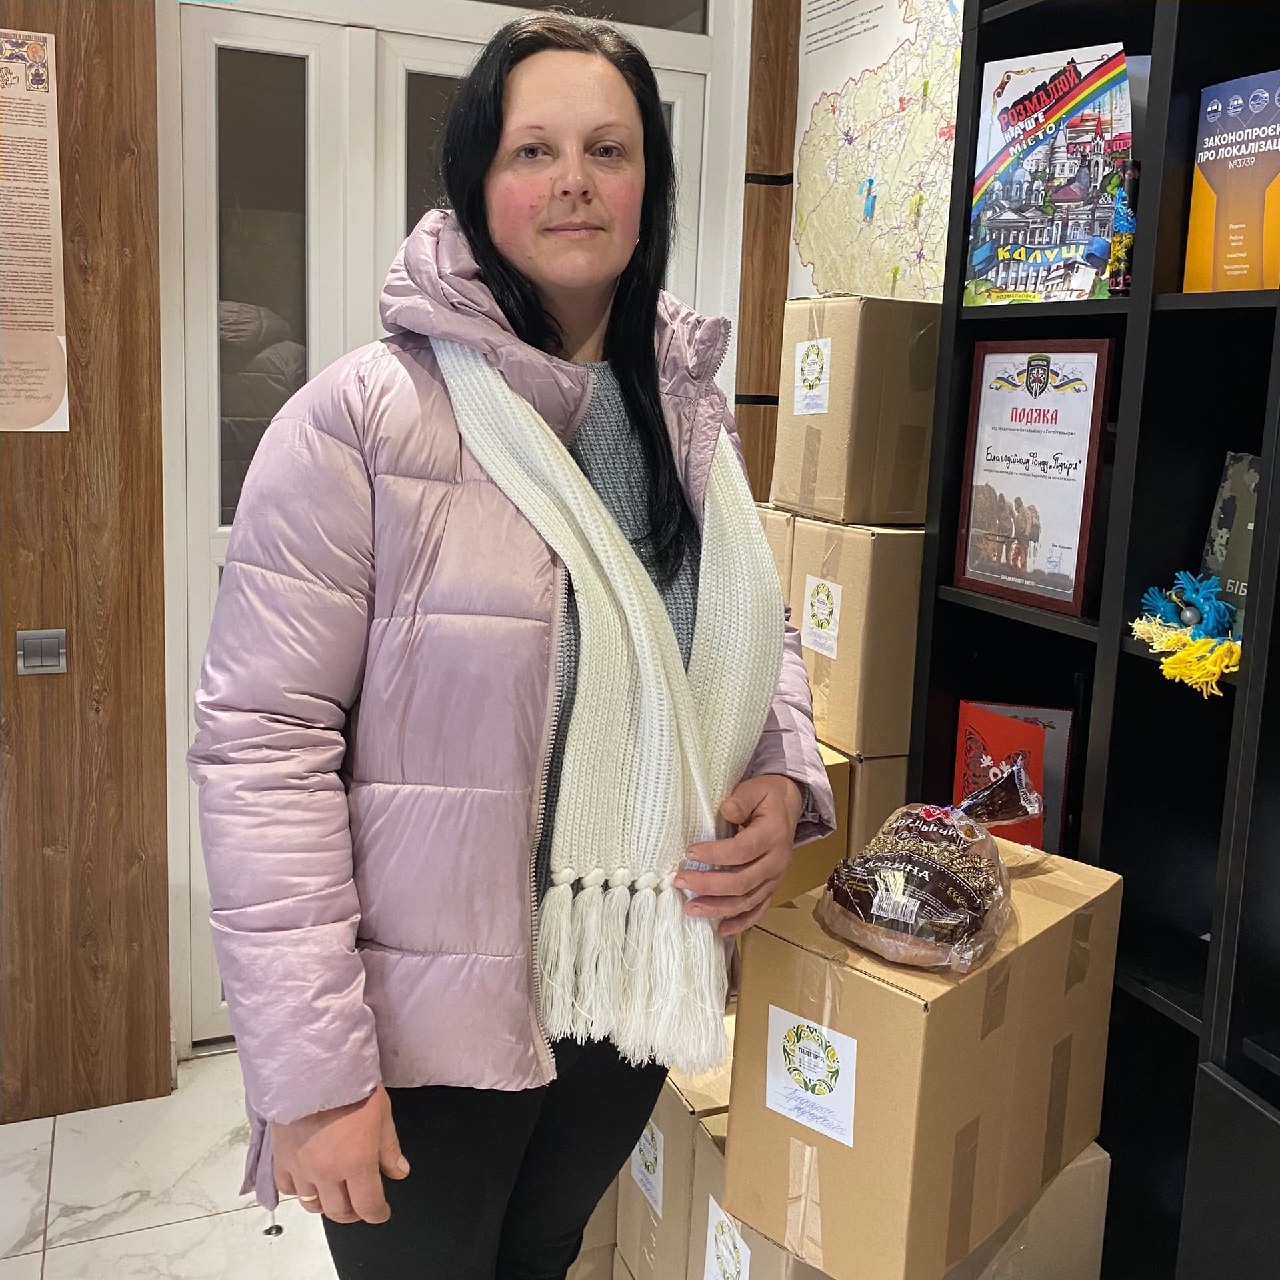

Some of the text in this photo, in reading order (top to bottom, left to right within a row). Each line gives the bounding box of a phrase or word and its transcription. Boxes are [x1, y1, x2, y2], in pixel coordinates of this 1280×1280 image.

[998, 64, 1081, 133] РОЗМАЛЮЙ
[1003, 114, 1046, 145] НАШЕ
[1008, 122, 1057, 157] МІСТО
[1197, 149, 1216, 164] ПРО
[997, 243, 1086, 265] КАЛУШ
[1010, 407, 1059, 426] ПОДЯКА
[1225, 578, 1248, 596] БІБ
